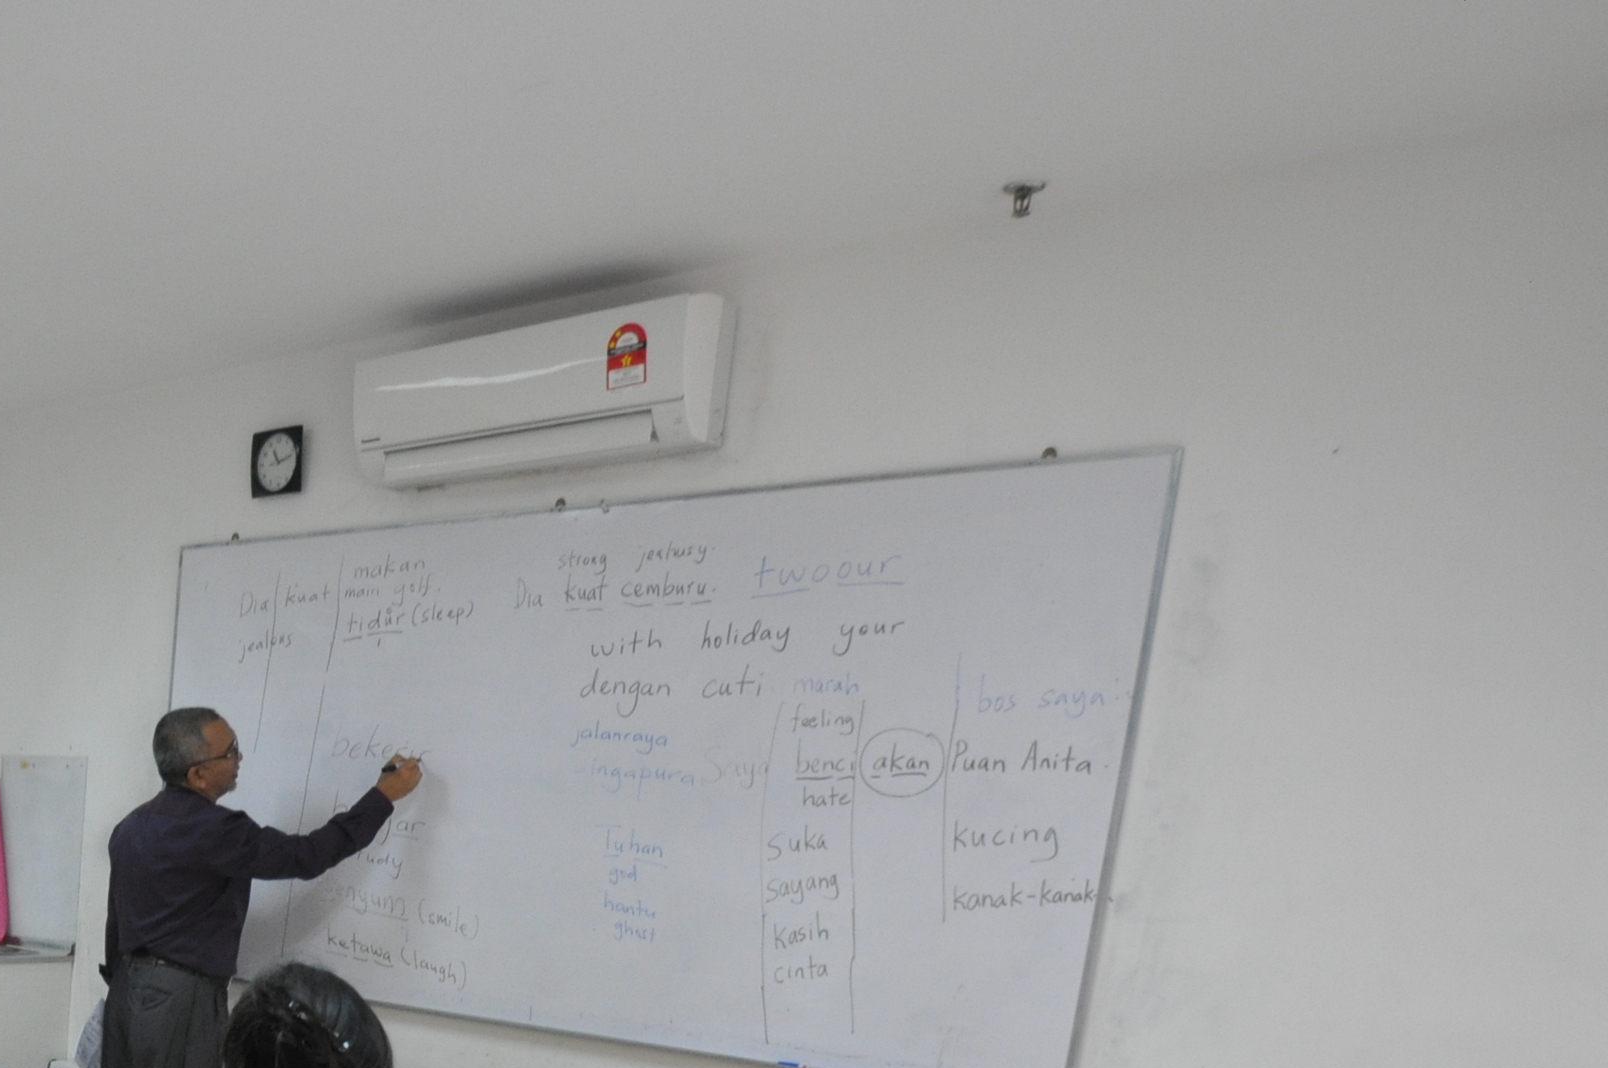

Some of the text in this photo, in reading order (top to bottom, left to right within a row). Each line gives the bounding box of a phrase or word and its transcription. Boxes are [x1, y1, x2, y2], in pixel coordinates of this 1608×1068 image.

[354, 553, 426, 580] makan
[558, 549, 607, 576] strong
[285, 583, 330, 608] kuat
[564, 573, 608, 603] kuat
[238, 628, 292, 664] jealous
[591, 619, 905, 658] with holiday your
[580, 664, 765, 718] dengan cuti
[793, 672, 859, 696] marah
[977, 672, 1016, 713] bos
[790, 702, 854, 736] feeling
[570, 722, 668, 756] jalanraya
[796, 738, 857, 774] benci
[872, 742, 930, 773] akan
[951, 740, 1007, 773] Puan
[802, 786, 852, 808] hate
[609, 864, 637, 885] god
[327, 923, 391, 963] ketawa
[774, 955, 829, 984] cinta
